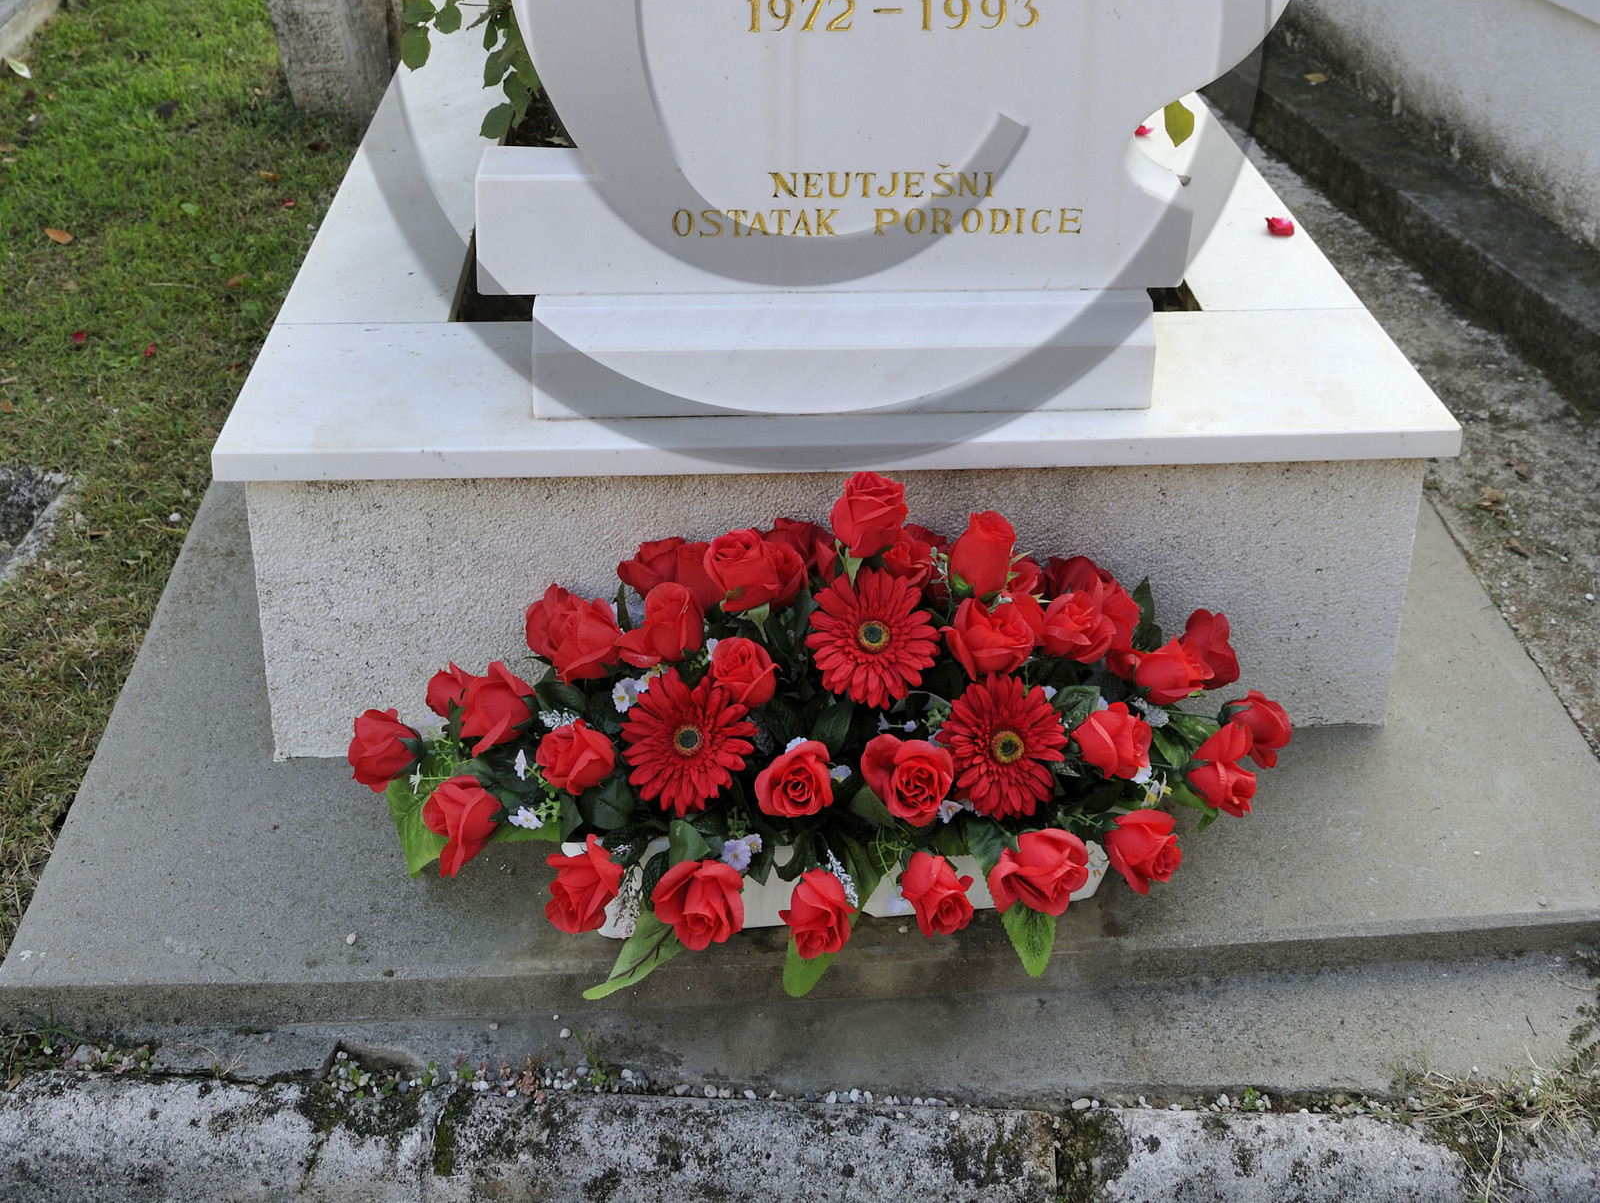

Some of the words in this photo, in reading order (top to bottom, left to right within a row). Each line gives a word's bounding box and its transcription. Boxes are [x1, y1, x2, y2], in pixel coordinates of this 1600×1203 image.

[767, 163, 995, 200] NEUTJEŠNI
[671, 207, 840, 239] OSTATAK
[873, 206, 1084, 237] PORODICE
